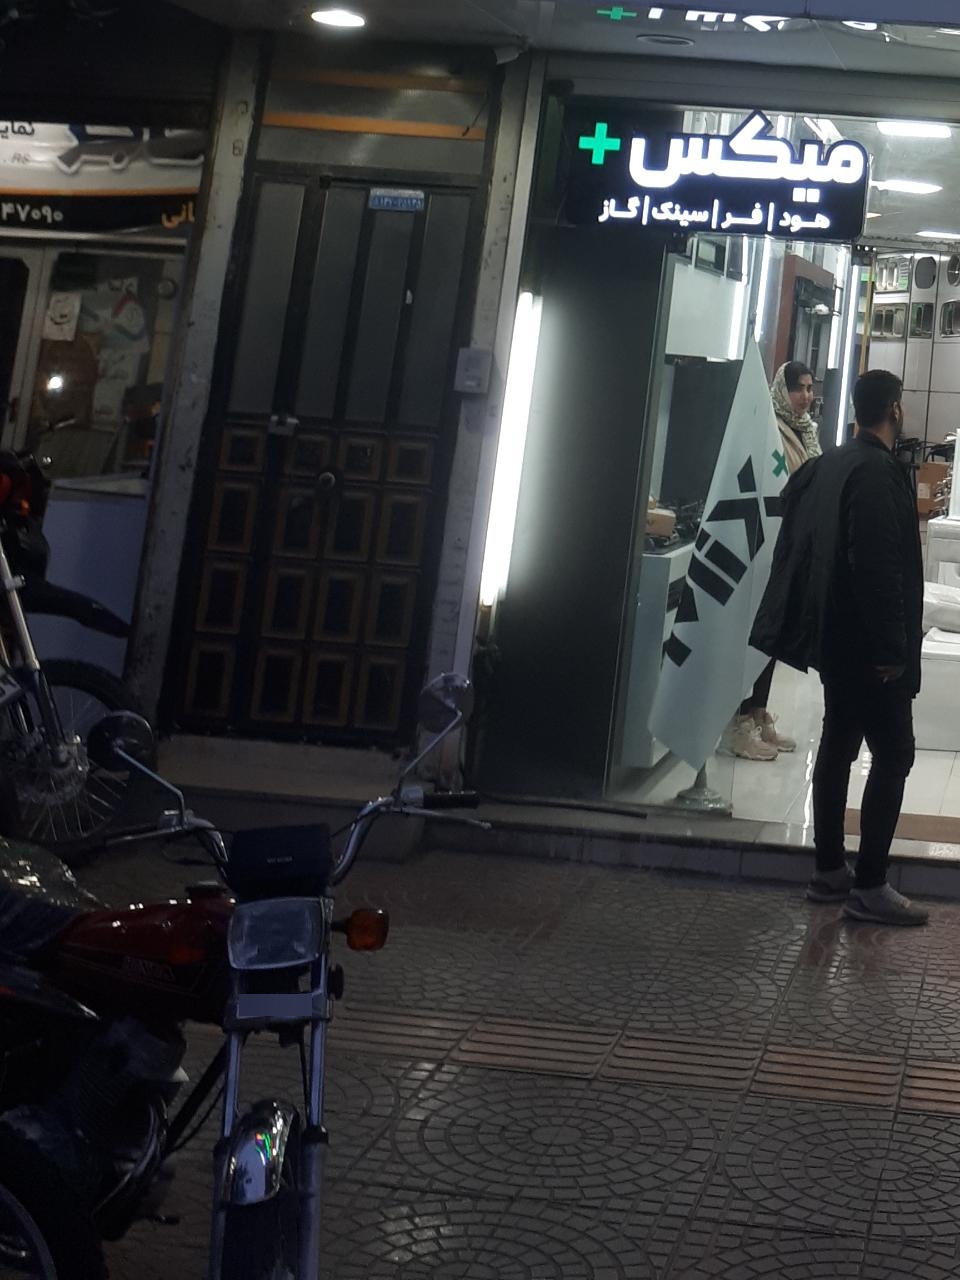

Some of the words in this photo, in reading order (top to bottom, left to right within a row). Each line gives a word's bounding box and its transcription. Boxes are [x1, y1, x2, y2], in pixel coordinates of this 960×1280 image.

[629, 112, 868, 203] میکس
[651, 200, 710, 228] سینک
[721, 201, 763, 228] فر
[778, 209, 831, 233] هود
